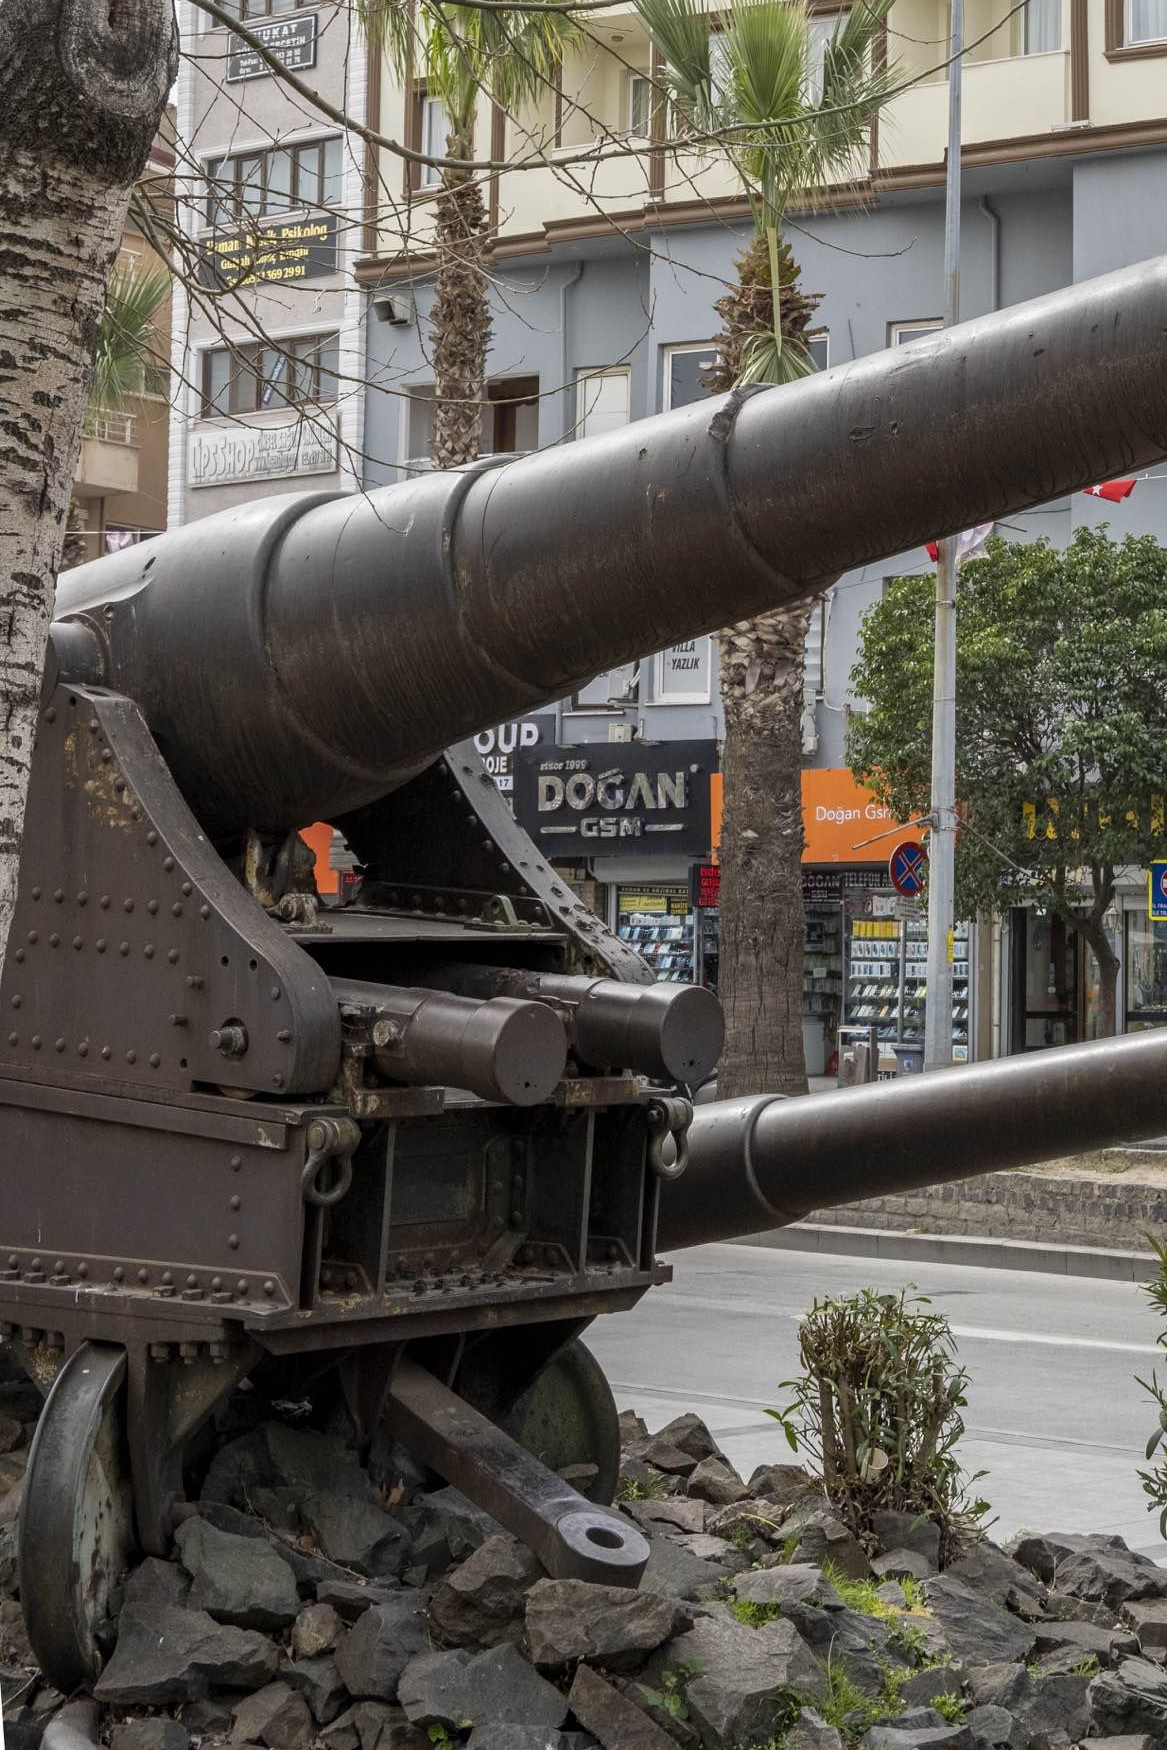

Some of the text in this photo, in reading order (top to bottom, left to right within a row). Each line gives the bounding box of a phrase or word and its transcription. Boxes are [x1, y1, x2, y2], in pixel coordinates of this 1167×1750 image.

[281, 224, 328, 241] Psikolog
[672, 658, 700, 670] YAZLIK
[473, 722, 540, 754] OUP
[541, 759, 588, 771] since 1999
[538, 768, 689, 812] DOĞAN
[815, 806, 861, 825] Doğan
[580, 817, 642, 838] GSM
